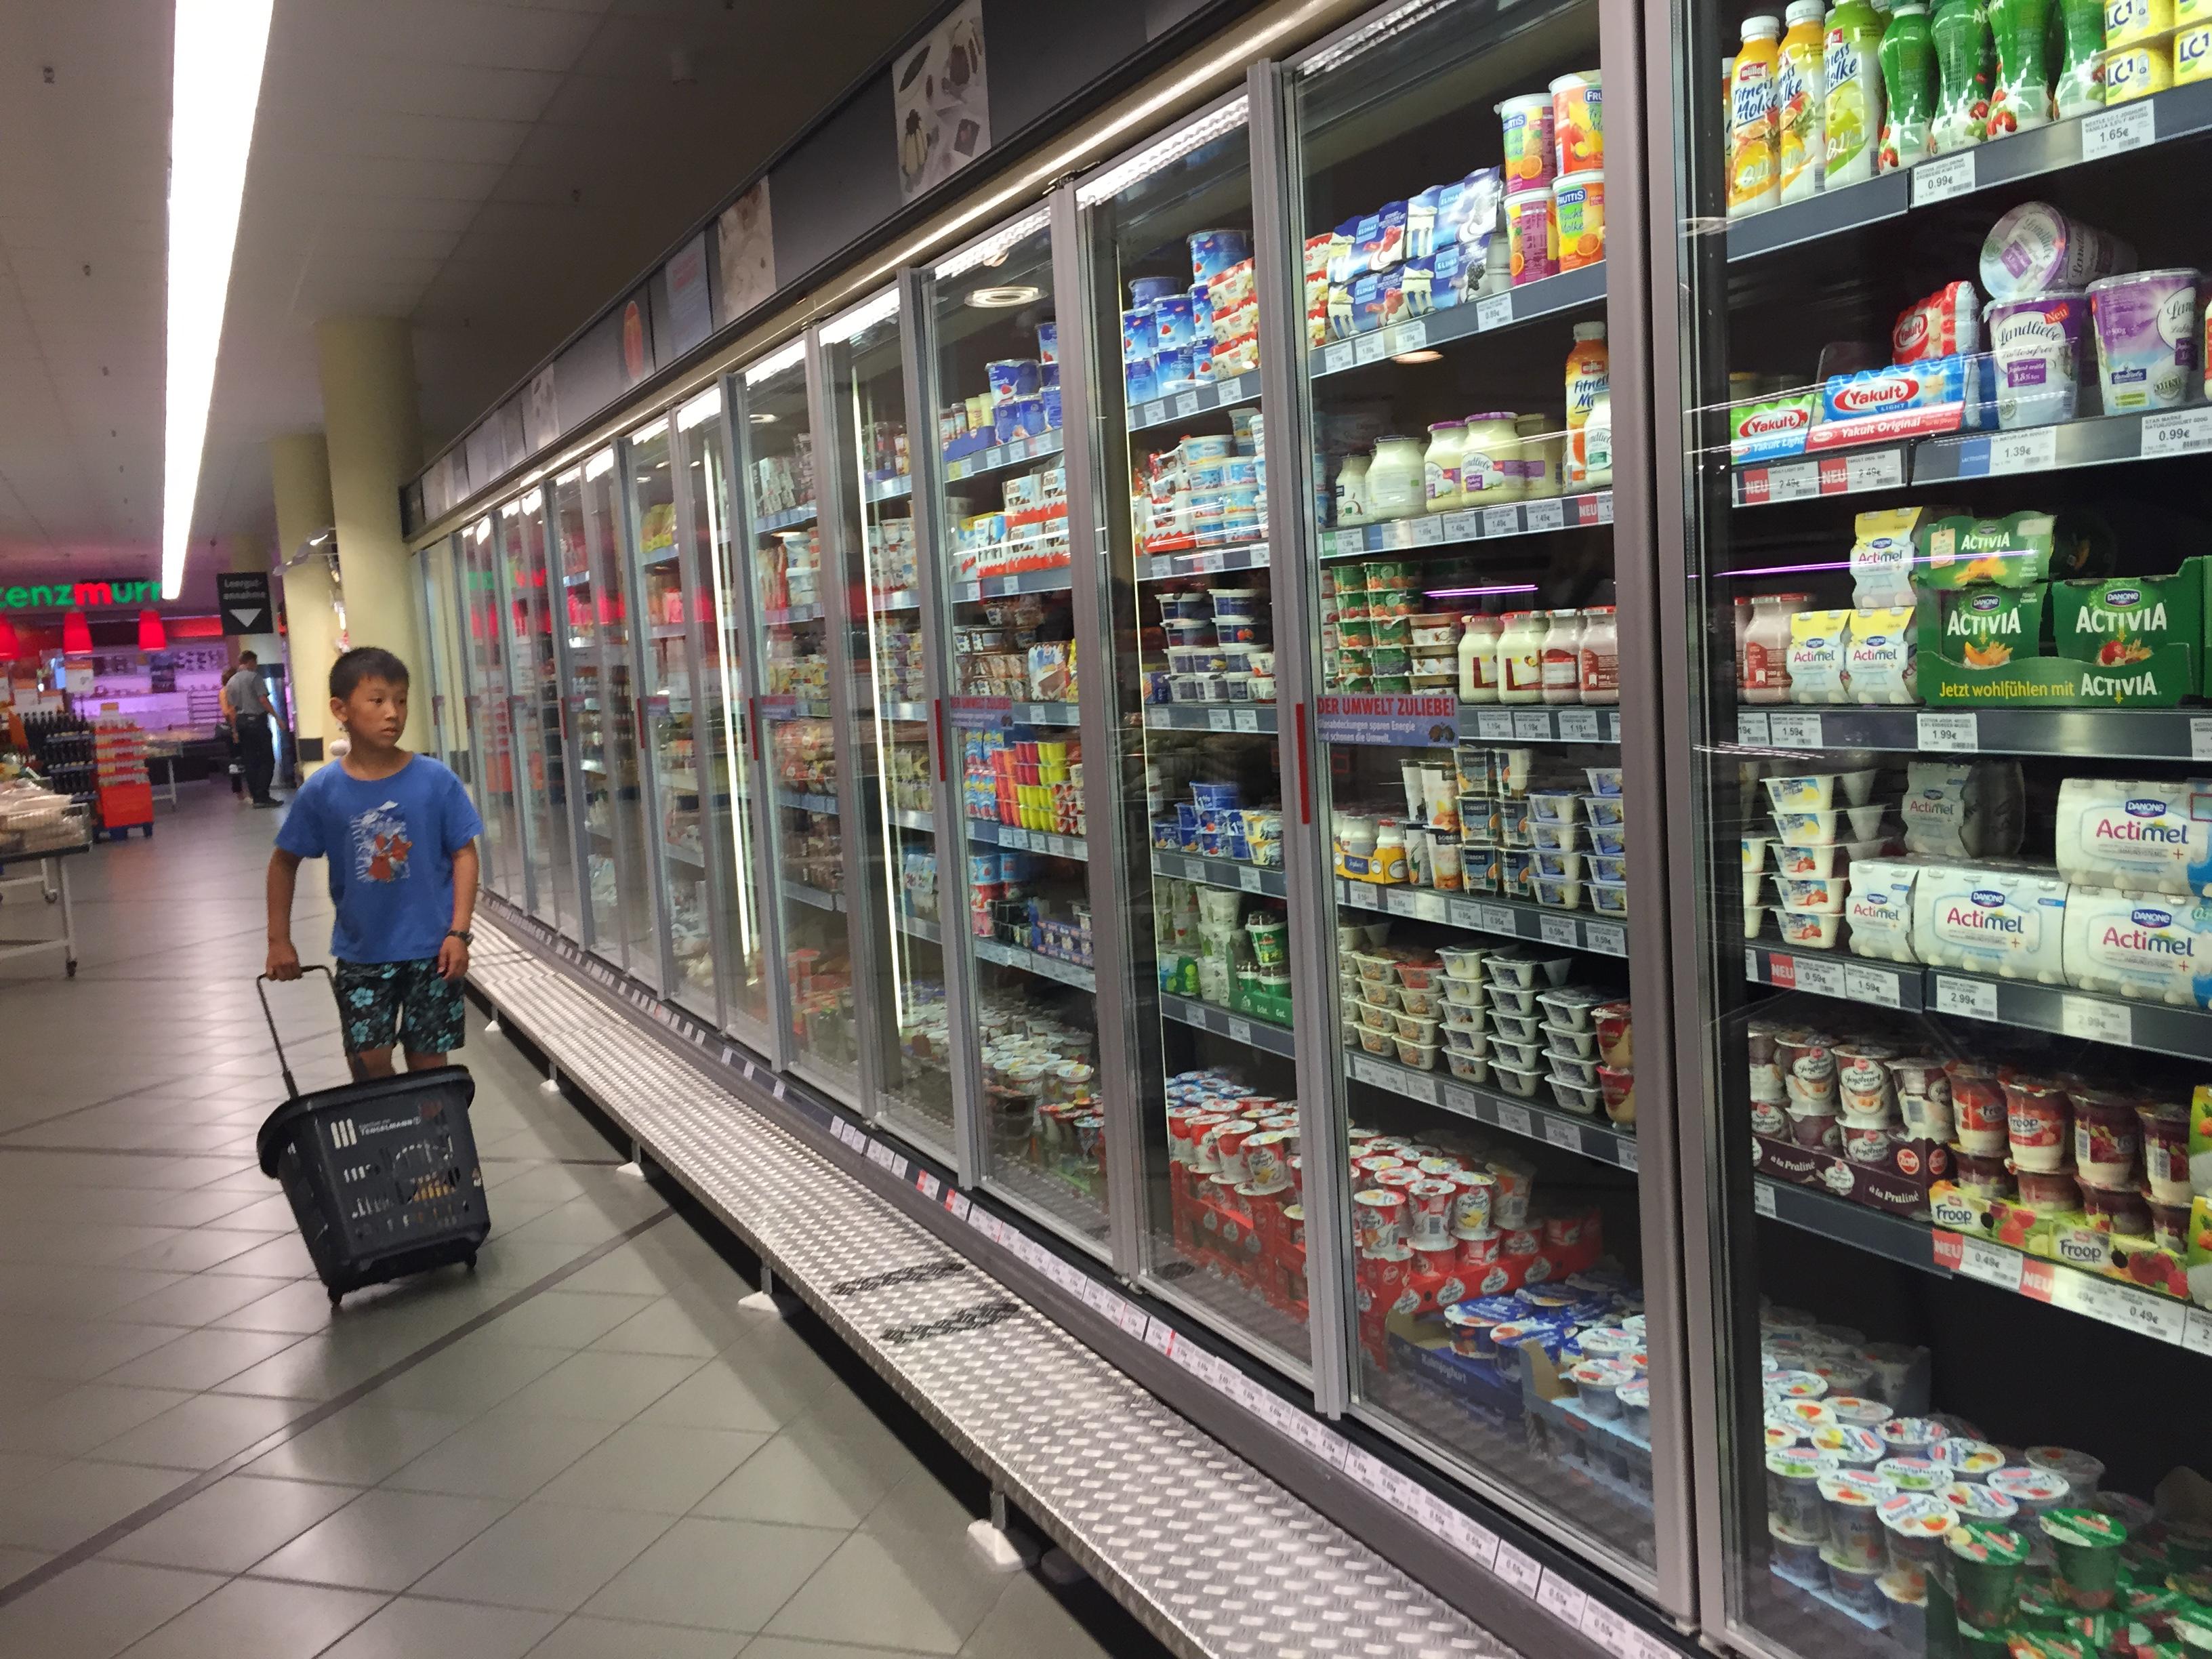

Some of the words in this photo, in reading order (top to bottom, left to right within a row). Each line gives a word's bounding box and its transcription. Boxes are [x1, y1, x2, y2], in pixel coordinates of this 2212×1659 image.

[2100, 127, 2129, 143] 1.65€
[1927, 175, 1953, 190] 0.99€
[1849, 385, 1904, 405] Yakult
[1751, 415, 1796, 434] Yakult
[1841, 425, 1875, 438] Yakult
[1877, 416, 1921, 433] Original
[2158, 428, 2190, 441] 0.99€
[2005, 445, 2032, 458] 1.39€
[1821, 468, 1847, 485] NEU
[1745, 480, 1769, 495] NEU
[1579, 504, 1597, 518] NEU
[1961, 531, 2011, 551] ACTIVIA
[1973, 598, 1999, 607] DANONE
[2108, 592, 2139, 602] DANONE
[1946, 607, 2022, 636] ACTIVIA
[2075, 602, 2167, 634] ACTIVIA
[1794, 650, 1836, 663] Actimel
[1853, 649, 1898, 661] Actimel
[1939, 681, 1970, 698] Jetzt
[1971, 680, 2048, 700] wohlfühlen
[2051, 681, 2076, 697] mit
[2081, 671, 2158, 696] ACTIVIA
[1317, 697, 1339, 715] DER
[1342, 697, 1395, 716] UMWELT
[1397, 697, 1456, 717] ZULIEBE!
[1910, 800, 1955, 815] Actimel
[2127, 802, 2165, 813] DANONE
[2096, 819, 2189, 844] Actimel
[1972, 892, 2004, 903] DANONE
[1853, 903, 1900, 922] Actimel
[1946, 907, 2024, 935] Actimel
[2134, 911, 2171, 923] DANONE
[2103, 926, 2195, 958] Actimel
[1770, 963, 1795, 979] NEU
[1950, 992, 1975, 1006] 2.99€
[1936, 1204, 1972, 1225] Froop
[1933, 1240, 1963, 1258] NEU
[2060, 1240, 2102, 1263] Froop
[2024, 1271, 2053, 1293] NEU
